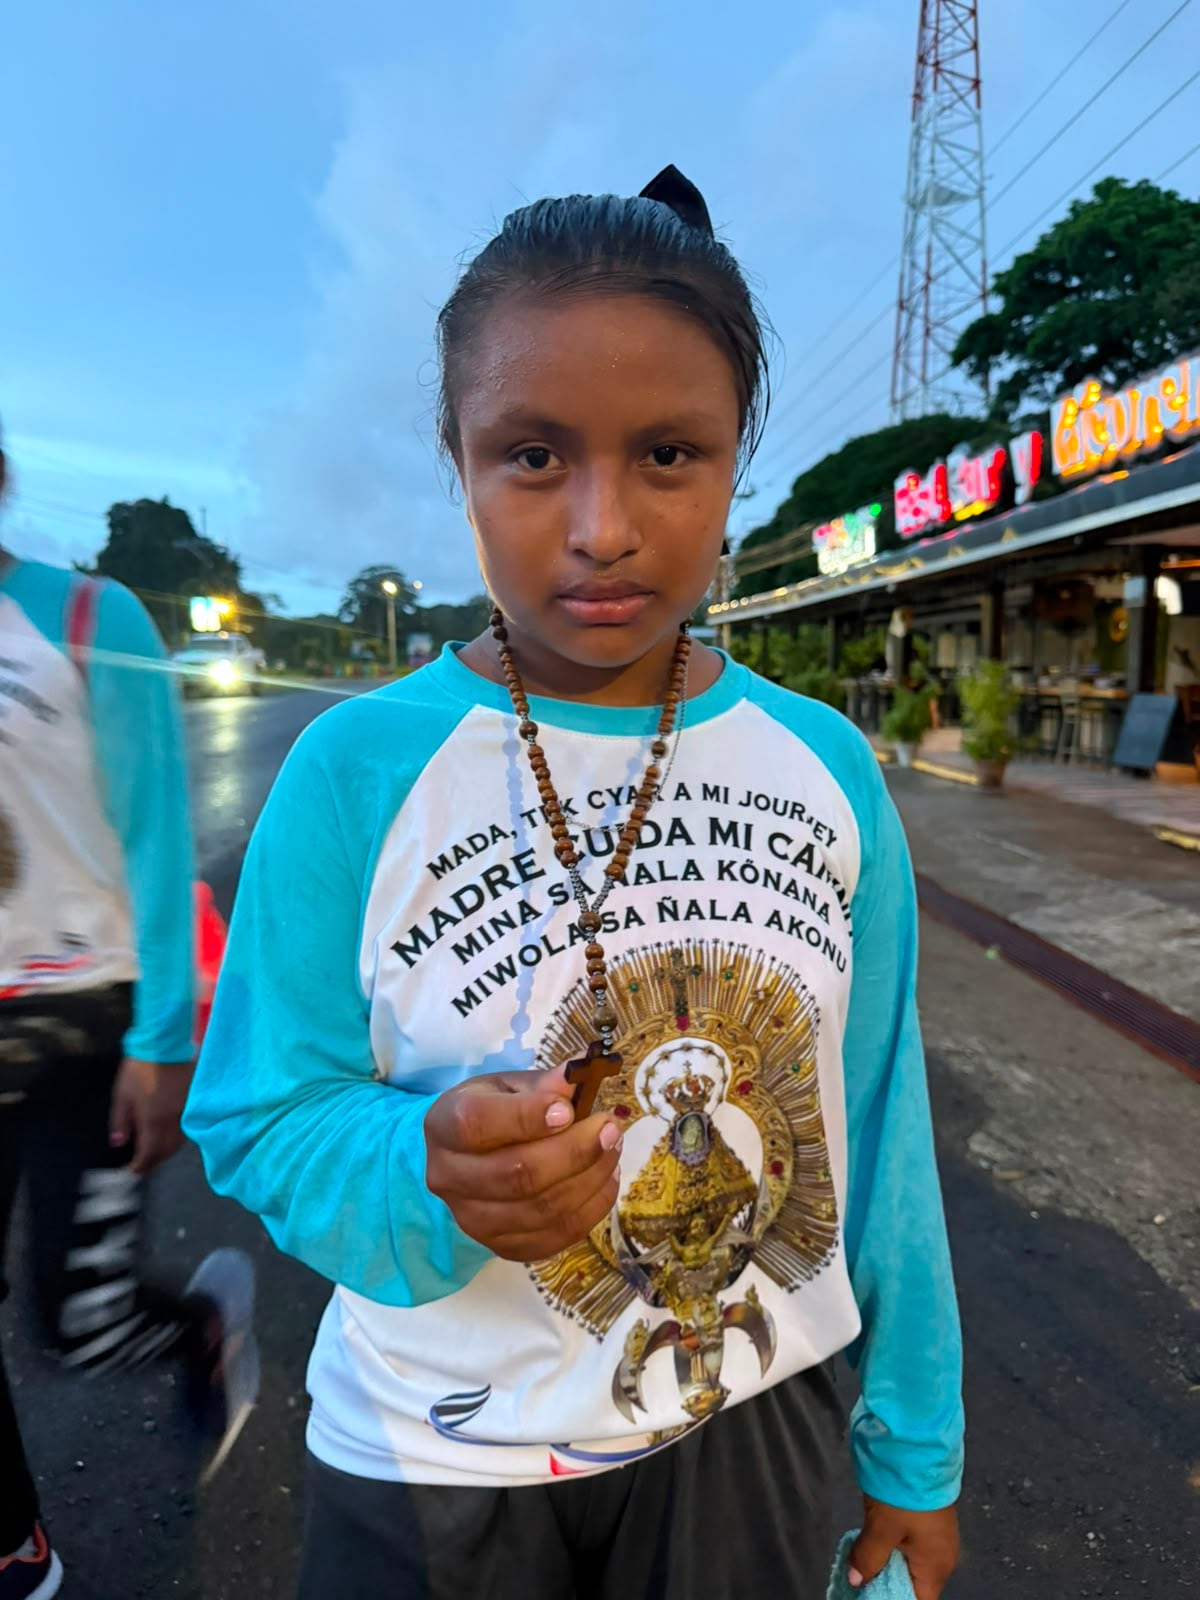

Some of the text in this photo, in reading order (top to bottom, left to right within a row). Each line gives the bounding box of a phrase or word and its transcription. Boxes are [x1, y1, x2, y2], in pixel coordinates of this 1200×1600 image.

[427, 824, 517, 880] MADA,
[520, 797, 579, 828] TK
[673, 783, 692, 801] A
[702, 783, 730, 804] MI
[390, 848, 546, 969] MADRE
[708, 817, 753, 851] MI
[451, 900, 542, 965] MINA
[547, 876, 596, 906] SA
[717, 859, 830, 925] KÖNANA
[451, 896, 847, 1018] MIWOLA SA ÑALA AKONU
